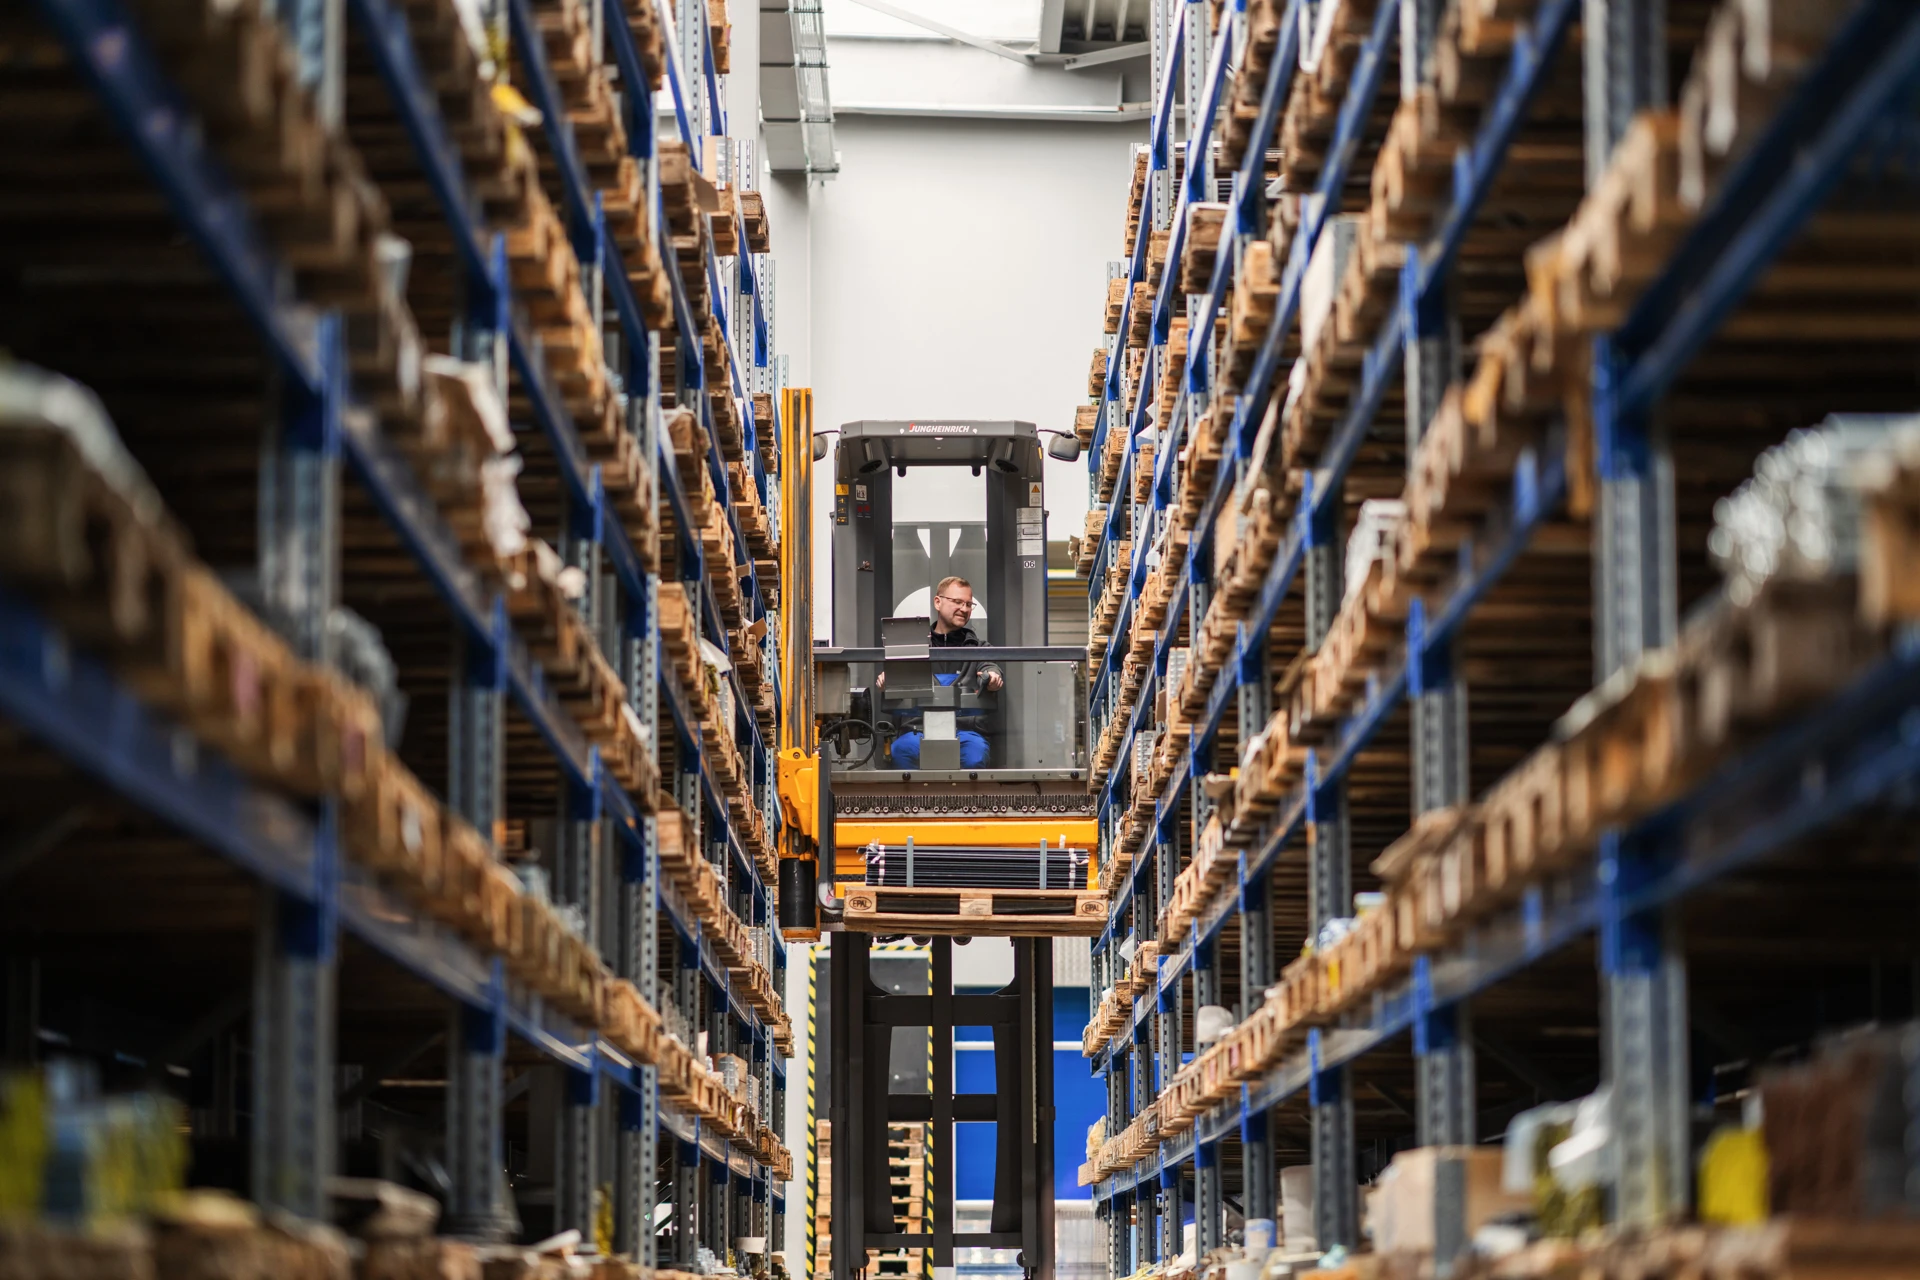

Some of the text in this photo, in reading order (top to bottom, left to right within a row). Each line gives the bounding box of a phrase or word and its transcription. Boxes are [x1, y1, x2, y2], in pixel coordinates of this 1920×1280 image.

[909, 423, 970, 433] JUNGHEINRICH
[1024, 560, 1035, 569] 06
[852, 899, 868, 908] EPAL
[1085, 903, 1100, 911] EPAL
